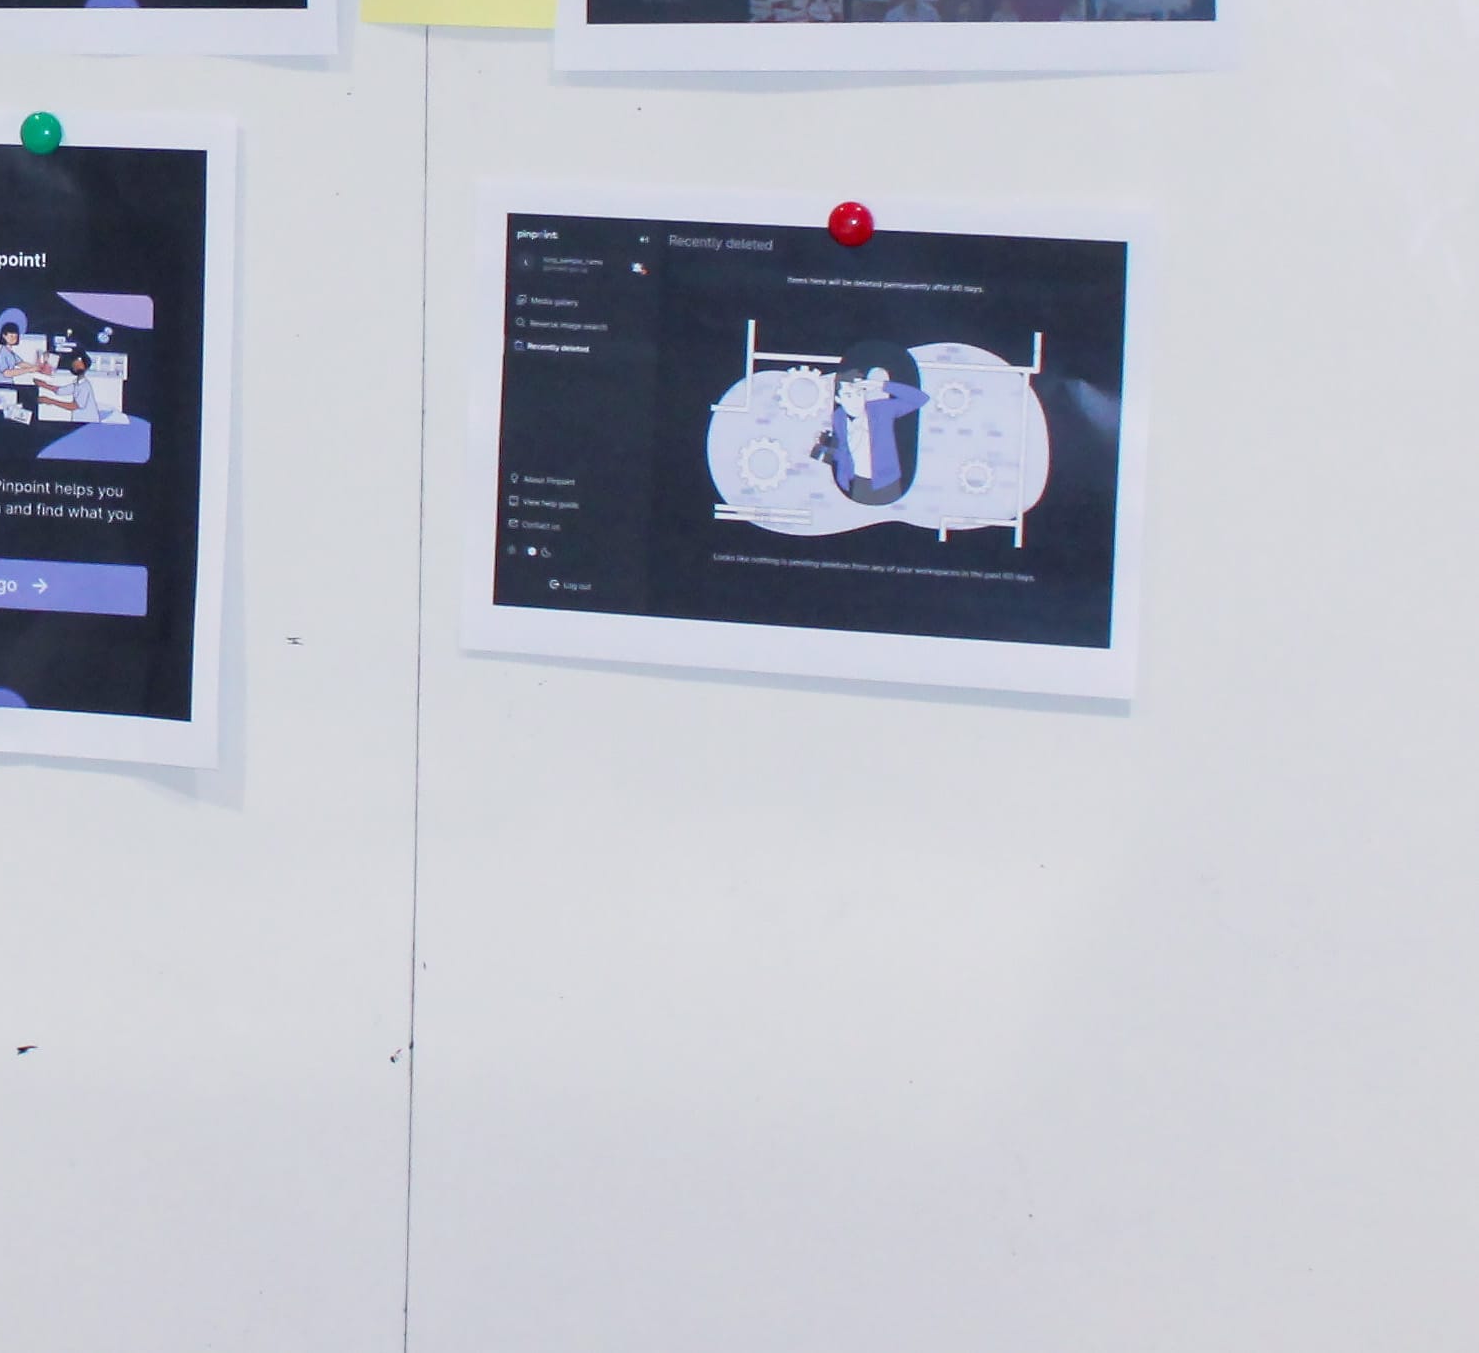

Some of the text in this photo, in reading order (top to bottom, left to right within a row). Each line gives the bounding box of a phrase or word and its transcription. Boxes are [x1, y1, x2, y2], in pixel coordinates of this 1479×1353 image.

[669, 234, 775, 251] Recently deleted
[527, 342, 591, 354] Recently deleted
[55, 483, 93, 498] helps
[98, 487, 123, 500] you
[5, 503, 31, 515] and
[36, 503, 63, 517] find
[67, 506, 102, 518] what
[107, 510, 133, 523] you
